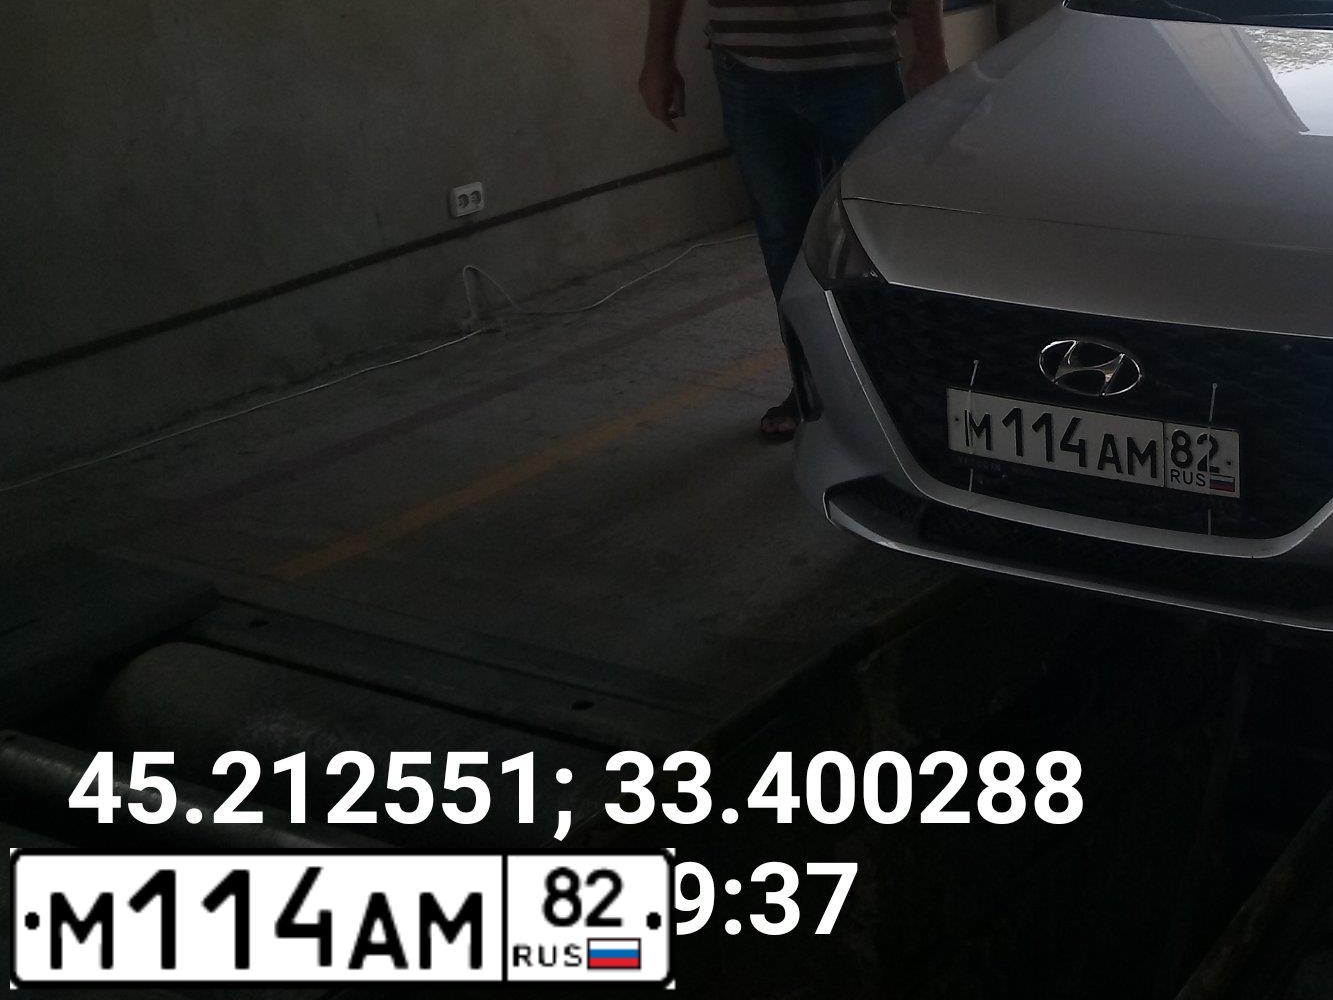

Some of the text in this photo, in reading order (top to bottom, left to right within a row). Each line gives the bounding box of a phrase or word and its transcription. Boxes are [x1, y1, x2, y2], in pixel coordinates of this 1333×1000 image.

[964, 407, 1158, 479] M114AM
[1170, 429, 1221, 474] 82
[1170, 469, 1206, 488] RUS
